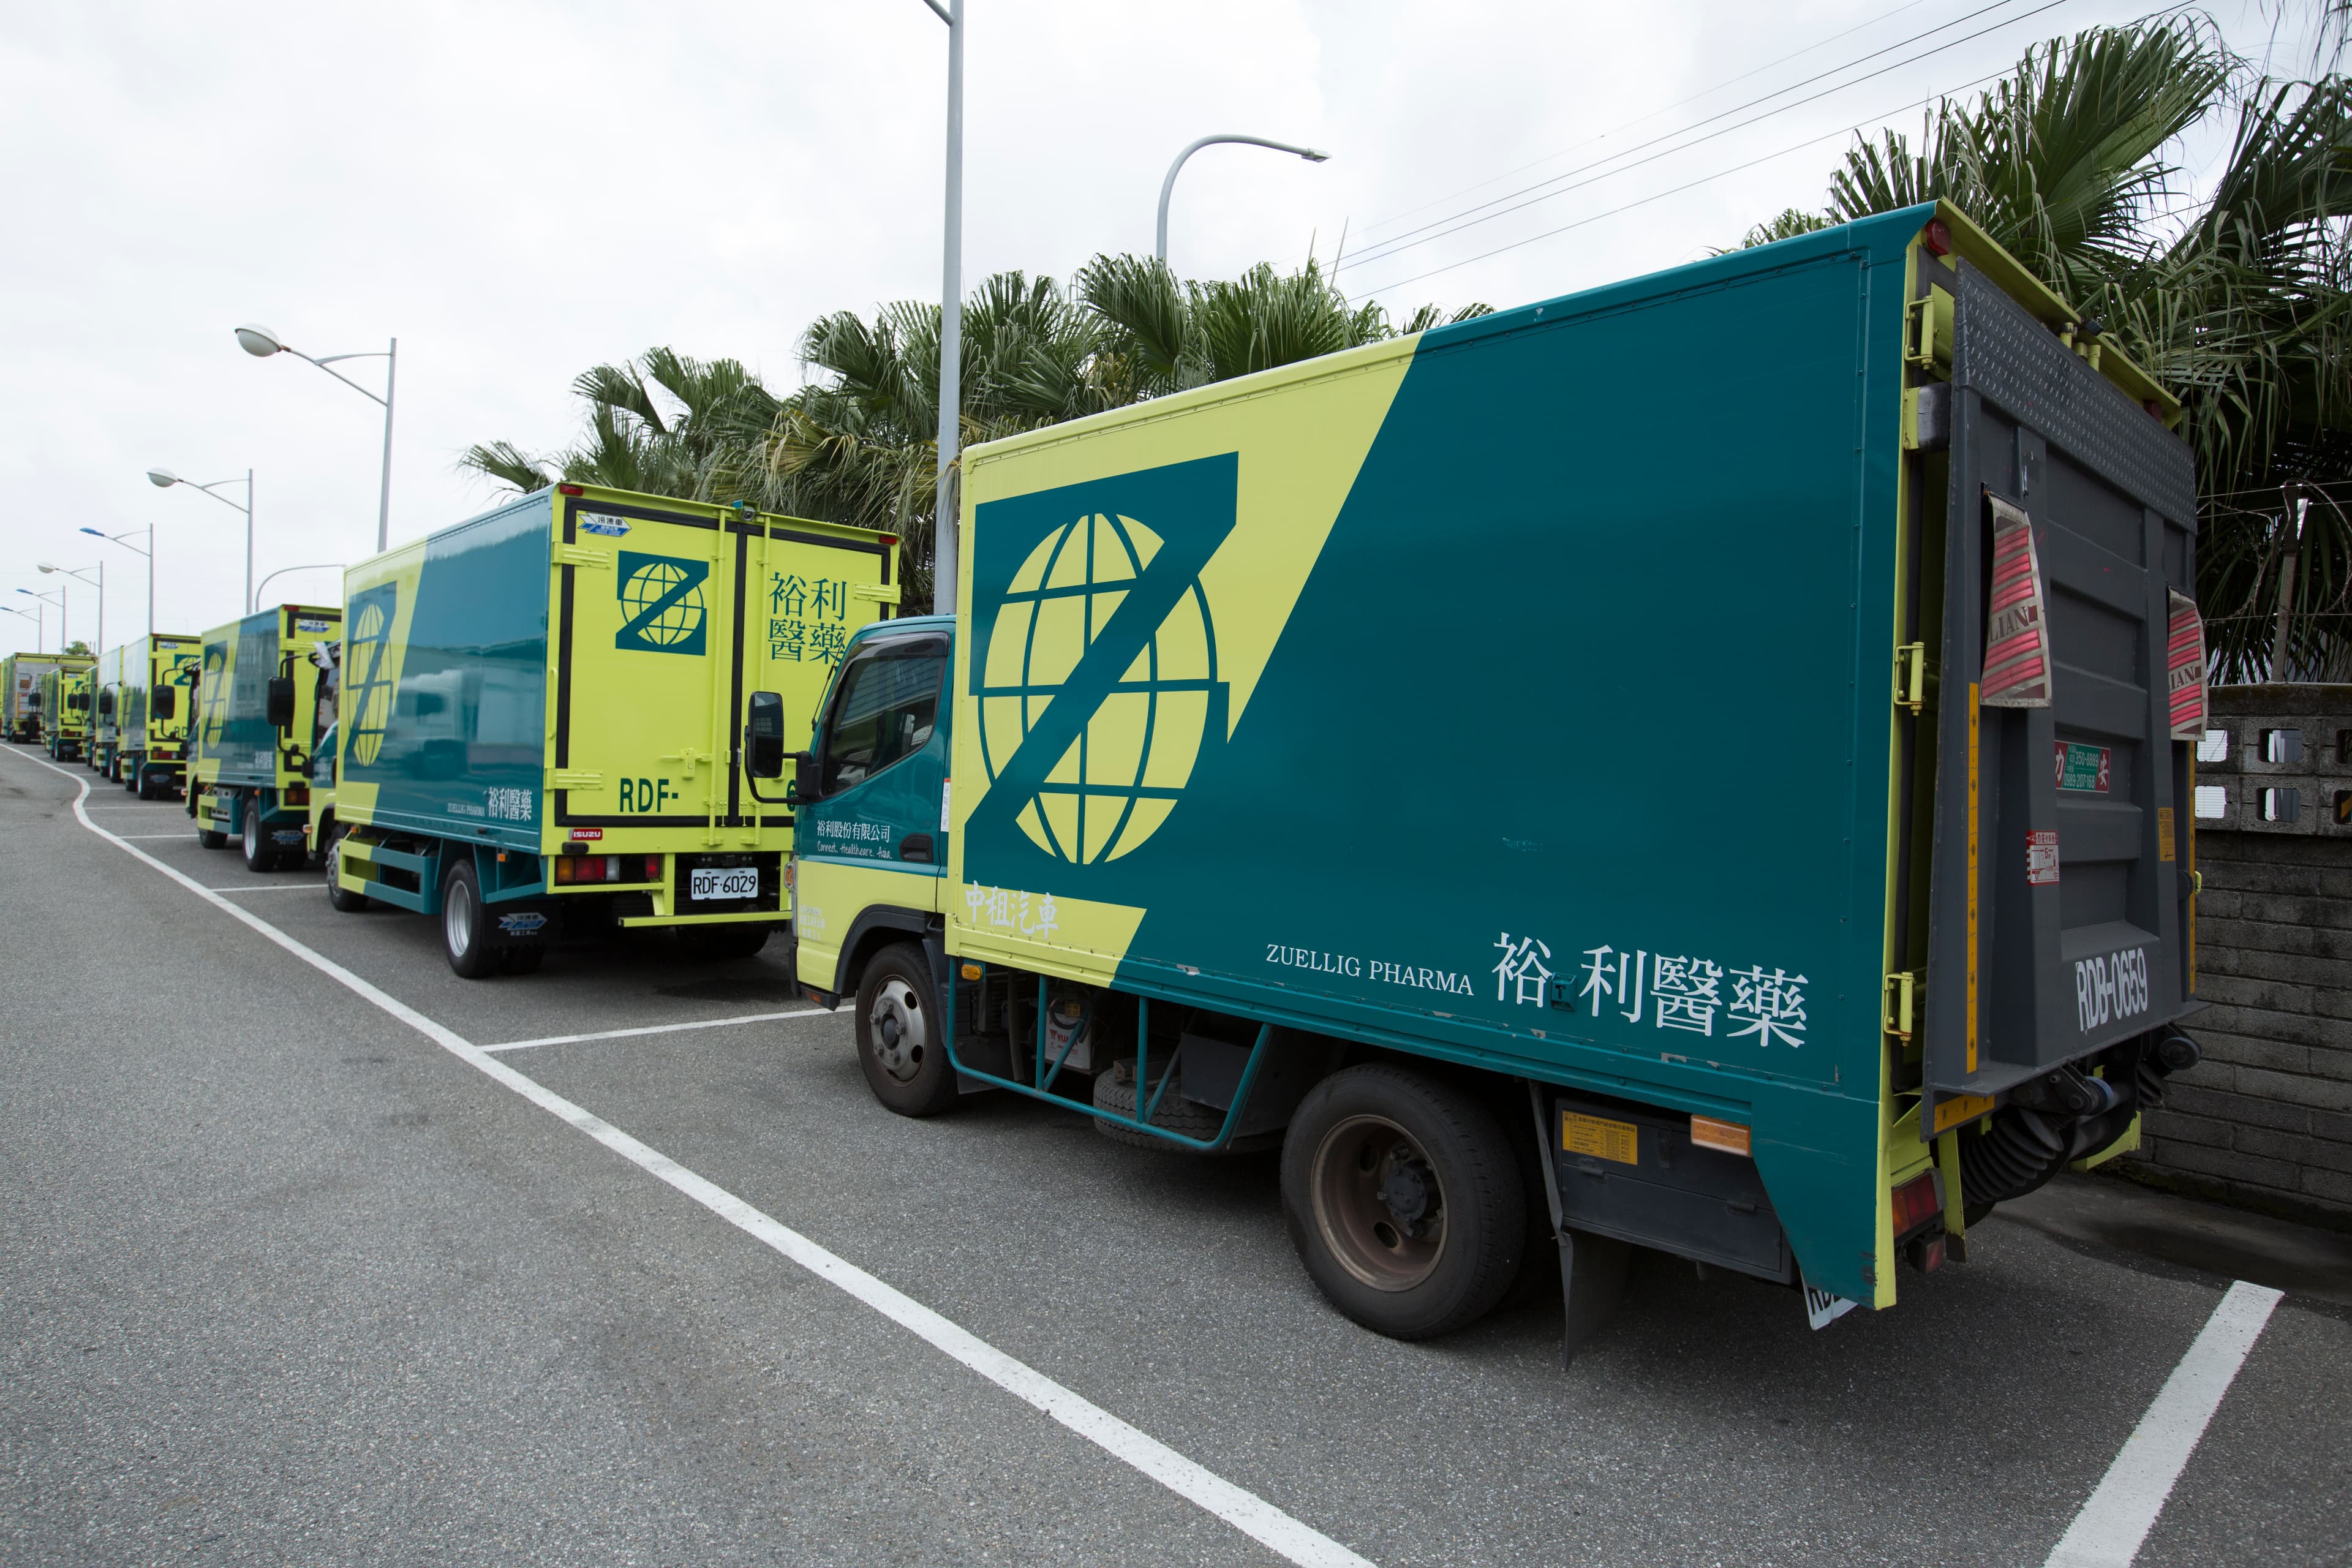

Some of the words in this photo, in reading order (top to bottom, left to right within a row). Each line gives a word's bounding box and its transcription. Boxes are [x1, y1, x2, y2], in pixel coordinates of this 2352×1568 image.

[769, 571, 847, 621] 裕利
[767, 619, 846, 665] 醫藥
[488, 786, 532, 821] 裕利醫藥
[816, 820, 891, 843] 裕利股份有限公司
[840, 843, 875, 857] Healthcare.
[965, 880, 1059, 941] 中租汽車
[1265, 943, 1361, 978] ZUELLIG
[1369, 960, 1474, 997] PHARMA
[1491, 932, 1809, 1049] 裕利醫藥
[2075, 948, 2148, 1032] RDB-0659
